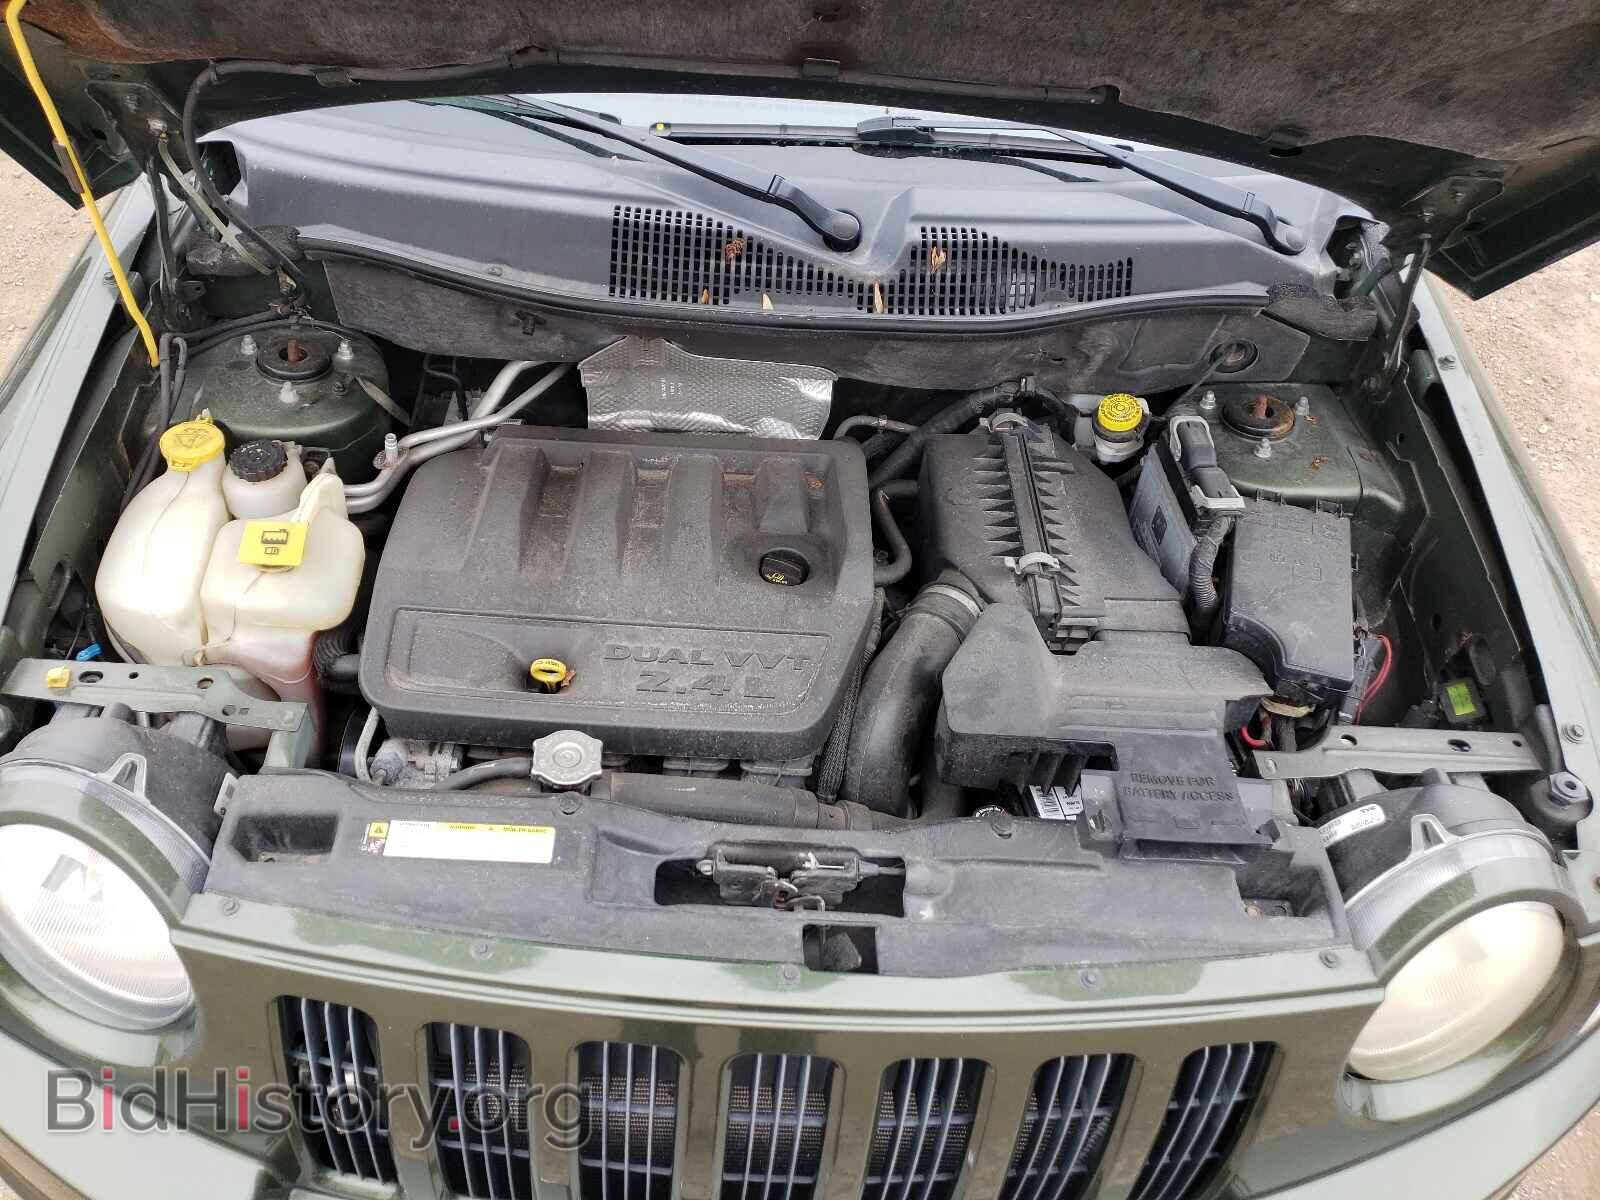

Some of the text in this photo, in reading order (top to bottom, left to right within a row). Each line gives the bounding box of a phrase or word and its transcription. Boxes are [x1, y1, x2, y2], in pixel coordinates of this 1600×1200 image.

[604, 644, 810, 671] DUAL VVT
[1129, 773, 1216, 787] REMOVE FOR
[1121, 786, 1234, 801] BATTERY ACCESS
